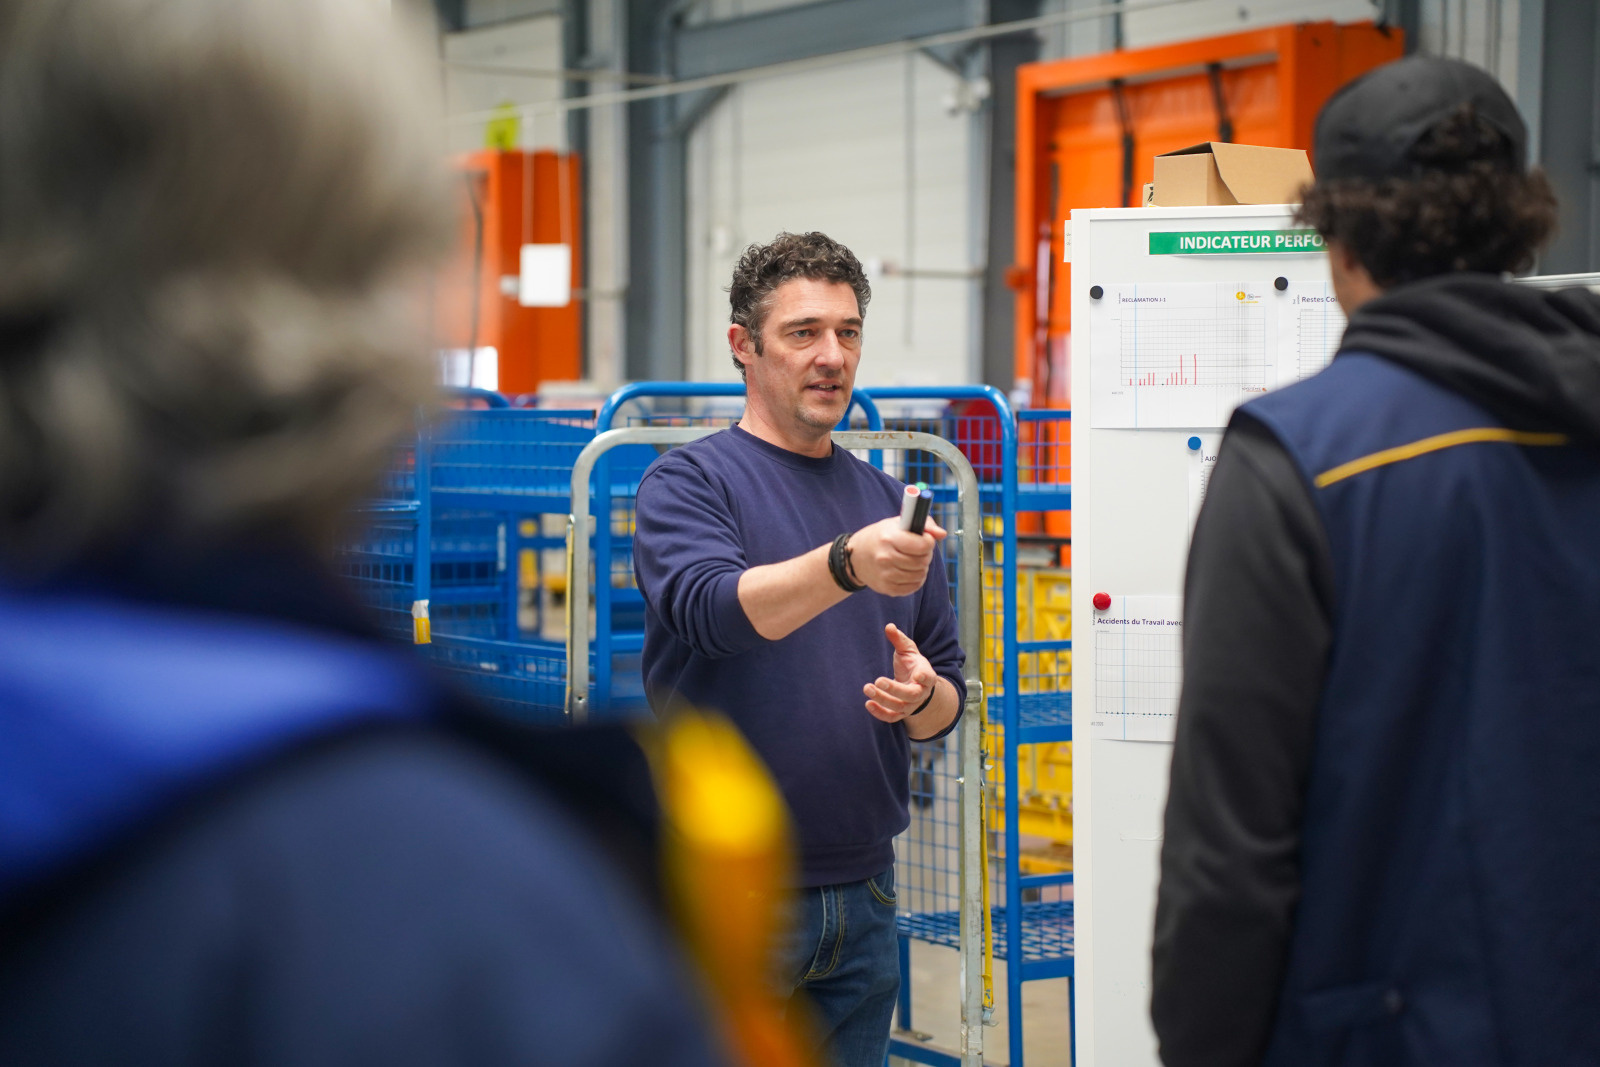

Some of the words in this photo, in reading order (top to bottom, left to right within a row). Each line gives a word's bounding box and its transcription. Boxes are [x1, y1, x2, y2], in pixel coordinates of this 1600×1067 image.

[1180, 235, 1271, 250] INDICATEUR
[1097, 617, 1130, 625] Accidents
[1142, 618, 1165, 626] Travail
